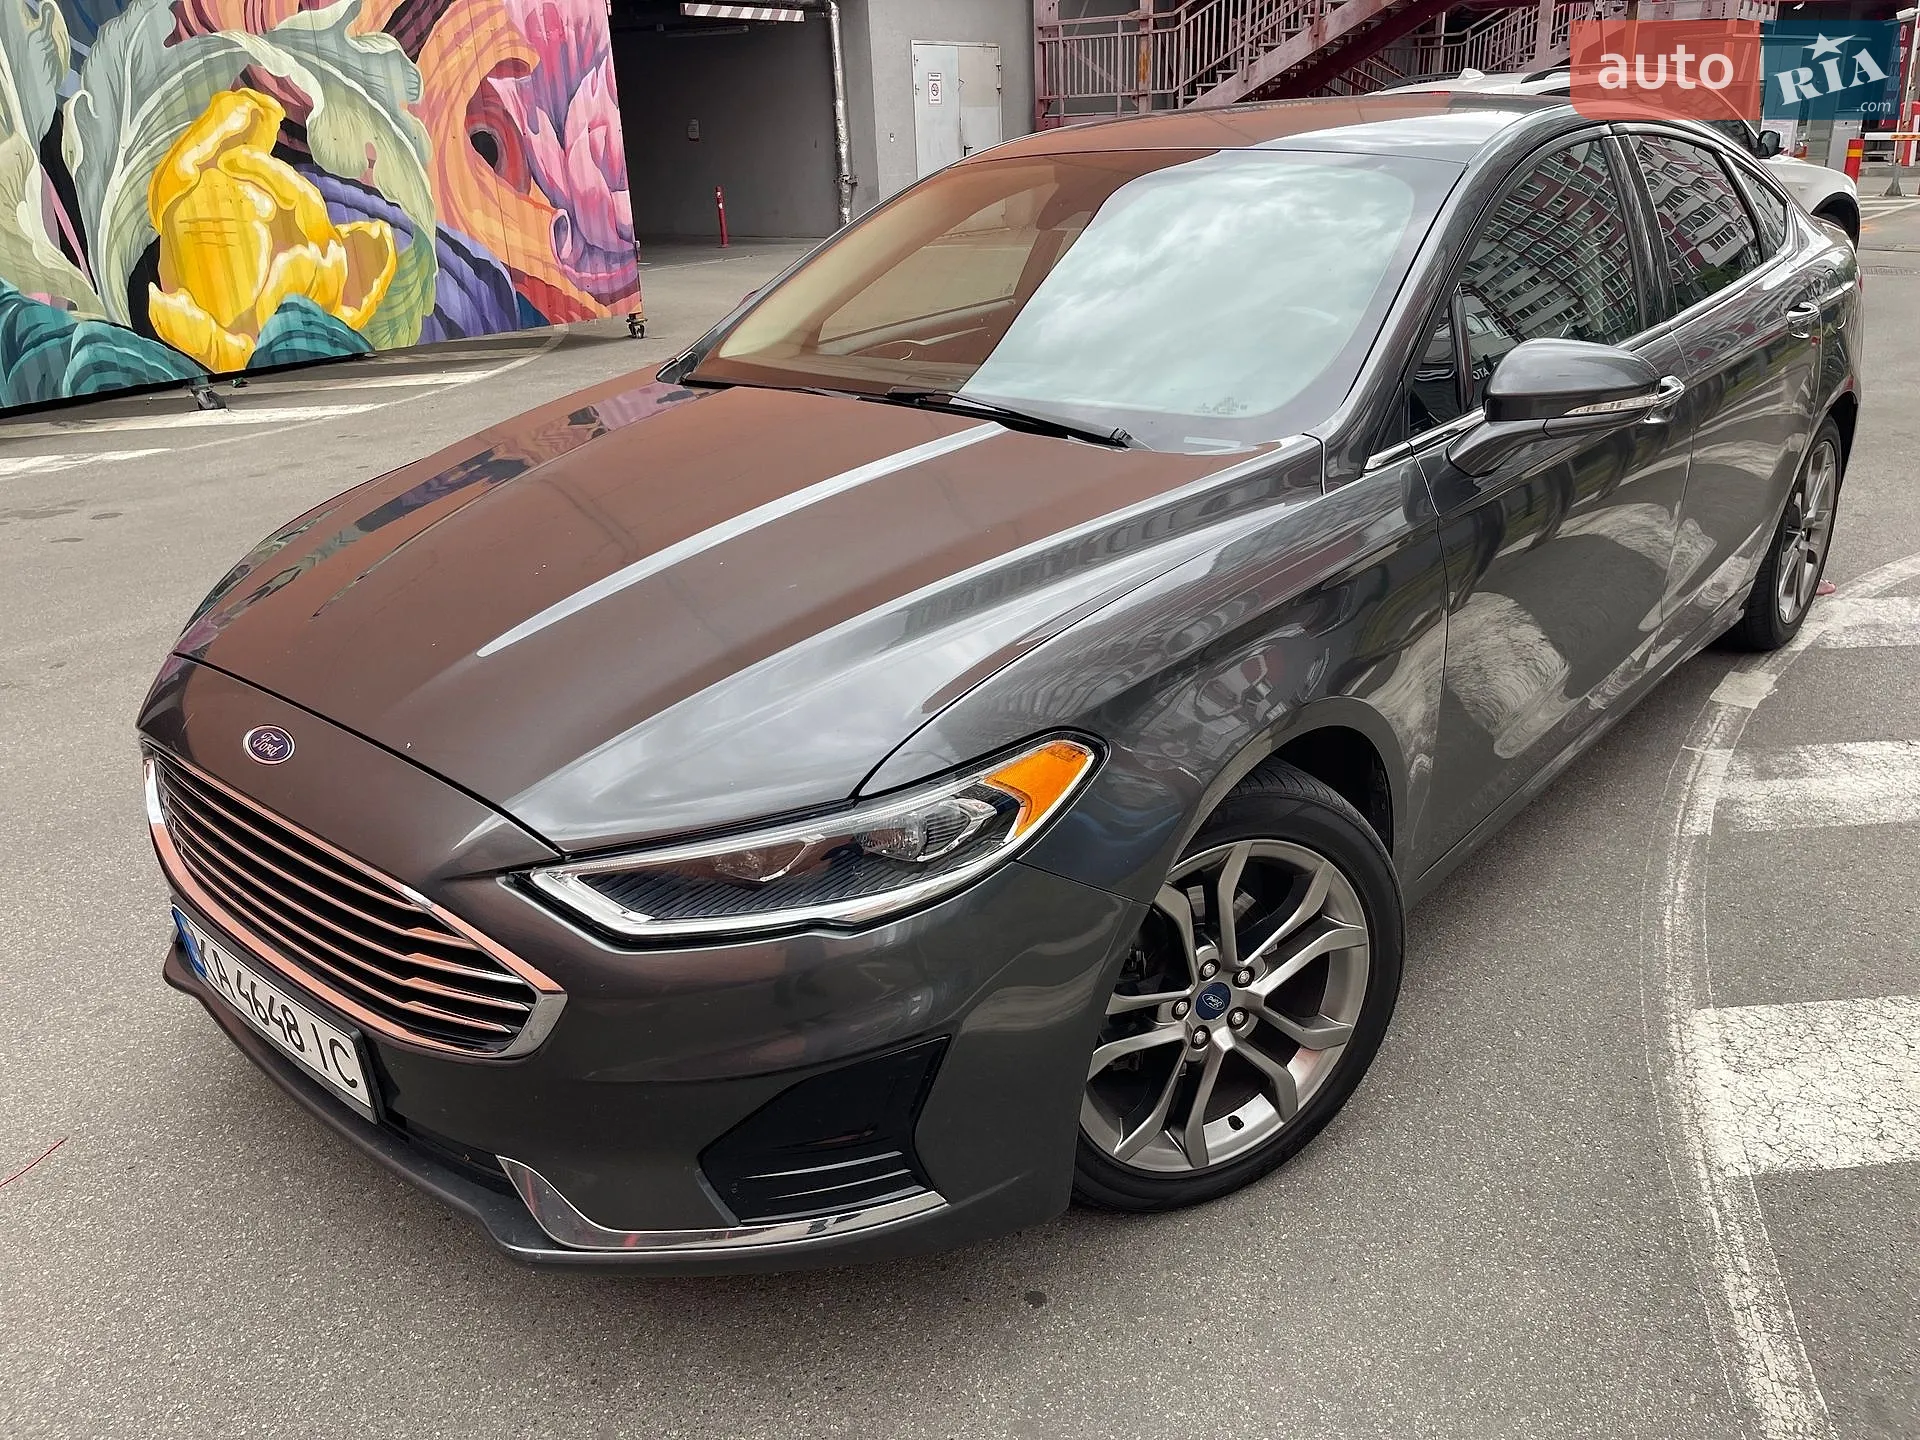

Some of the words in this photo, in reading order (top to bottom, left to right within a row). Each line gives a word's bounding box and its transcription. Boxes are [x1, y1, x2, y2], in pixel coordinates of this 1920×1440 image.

[253, 732, 283, 757] Ford
[235, 970, 305, 1053] 4648
[311, 1022, 358, 1089] IC
